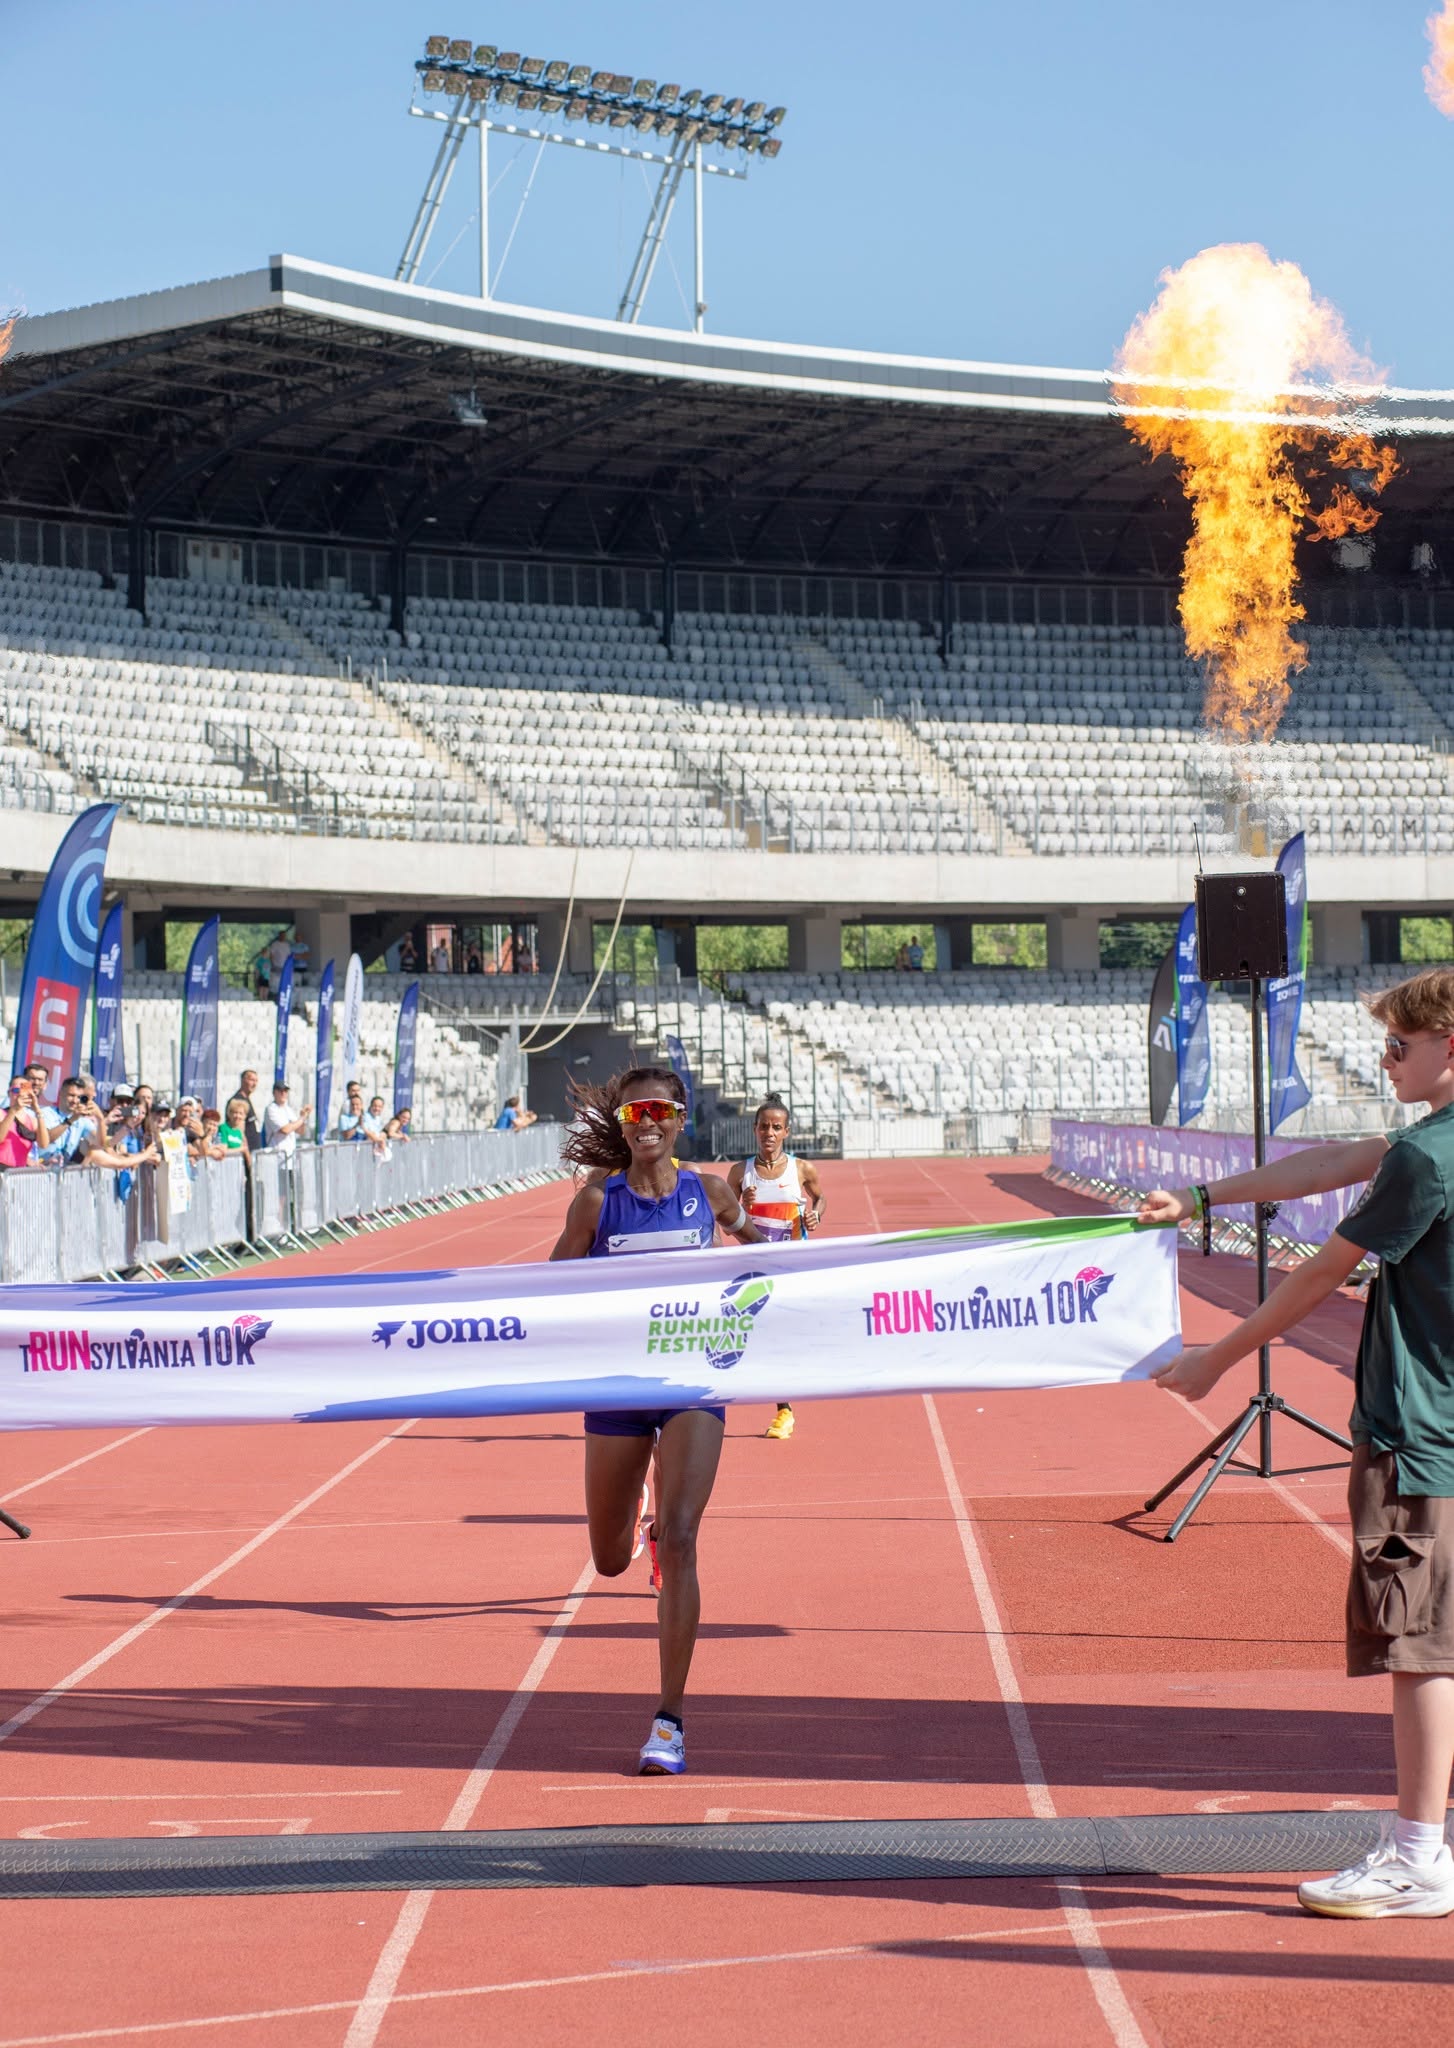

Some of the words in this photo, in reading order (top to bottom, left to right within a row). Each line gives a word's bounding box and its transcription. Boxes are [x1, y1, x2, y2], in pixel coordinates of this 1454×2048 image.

[1040, 1272, 1112, 1325] 10K
[650, 1301, 700, 1318] CLUJ
[648, 1315, 754, 1336] RUNNING
[198, 1320, 268, 1366] 10K
[647, 1333, 746, 1354] FESTIVAL
